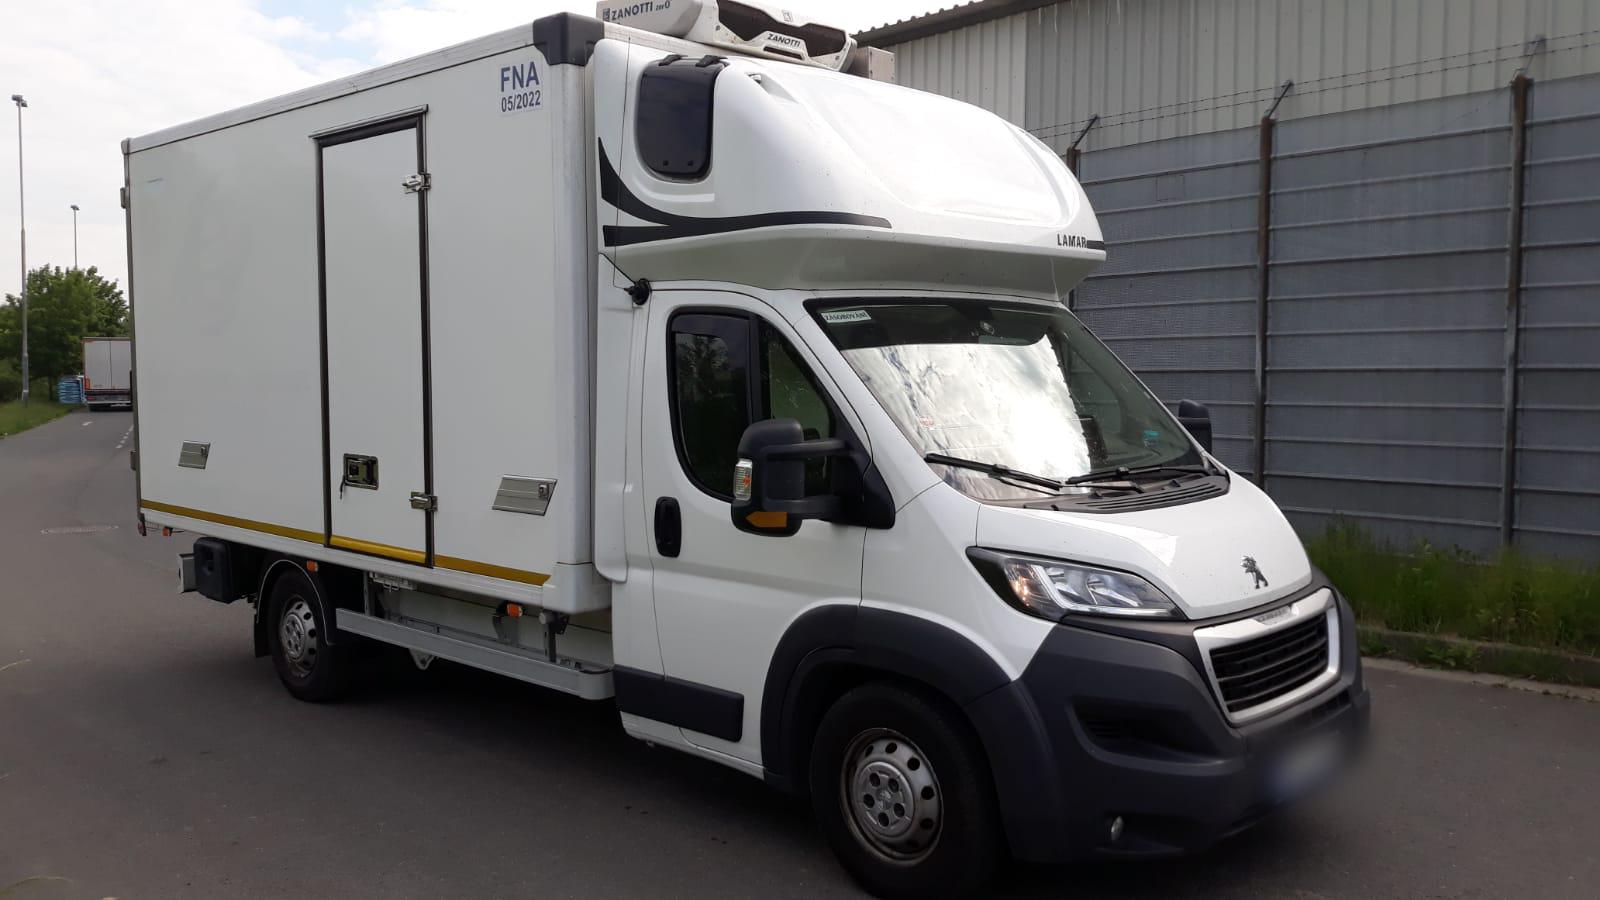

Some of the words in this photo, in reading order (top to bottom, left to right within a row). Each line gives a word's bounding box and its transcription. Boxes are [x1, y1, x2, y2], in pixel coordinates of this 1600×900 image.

[611, 1, 653, 20] ZANOTTI
[767, 33, 801, 48] ZANOTTI
[501, 61, 540, 92] FNA
[501, 90, 541, 112] 05/2022
[1057, 233, 1087, 249] LAMAR
